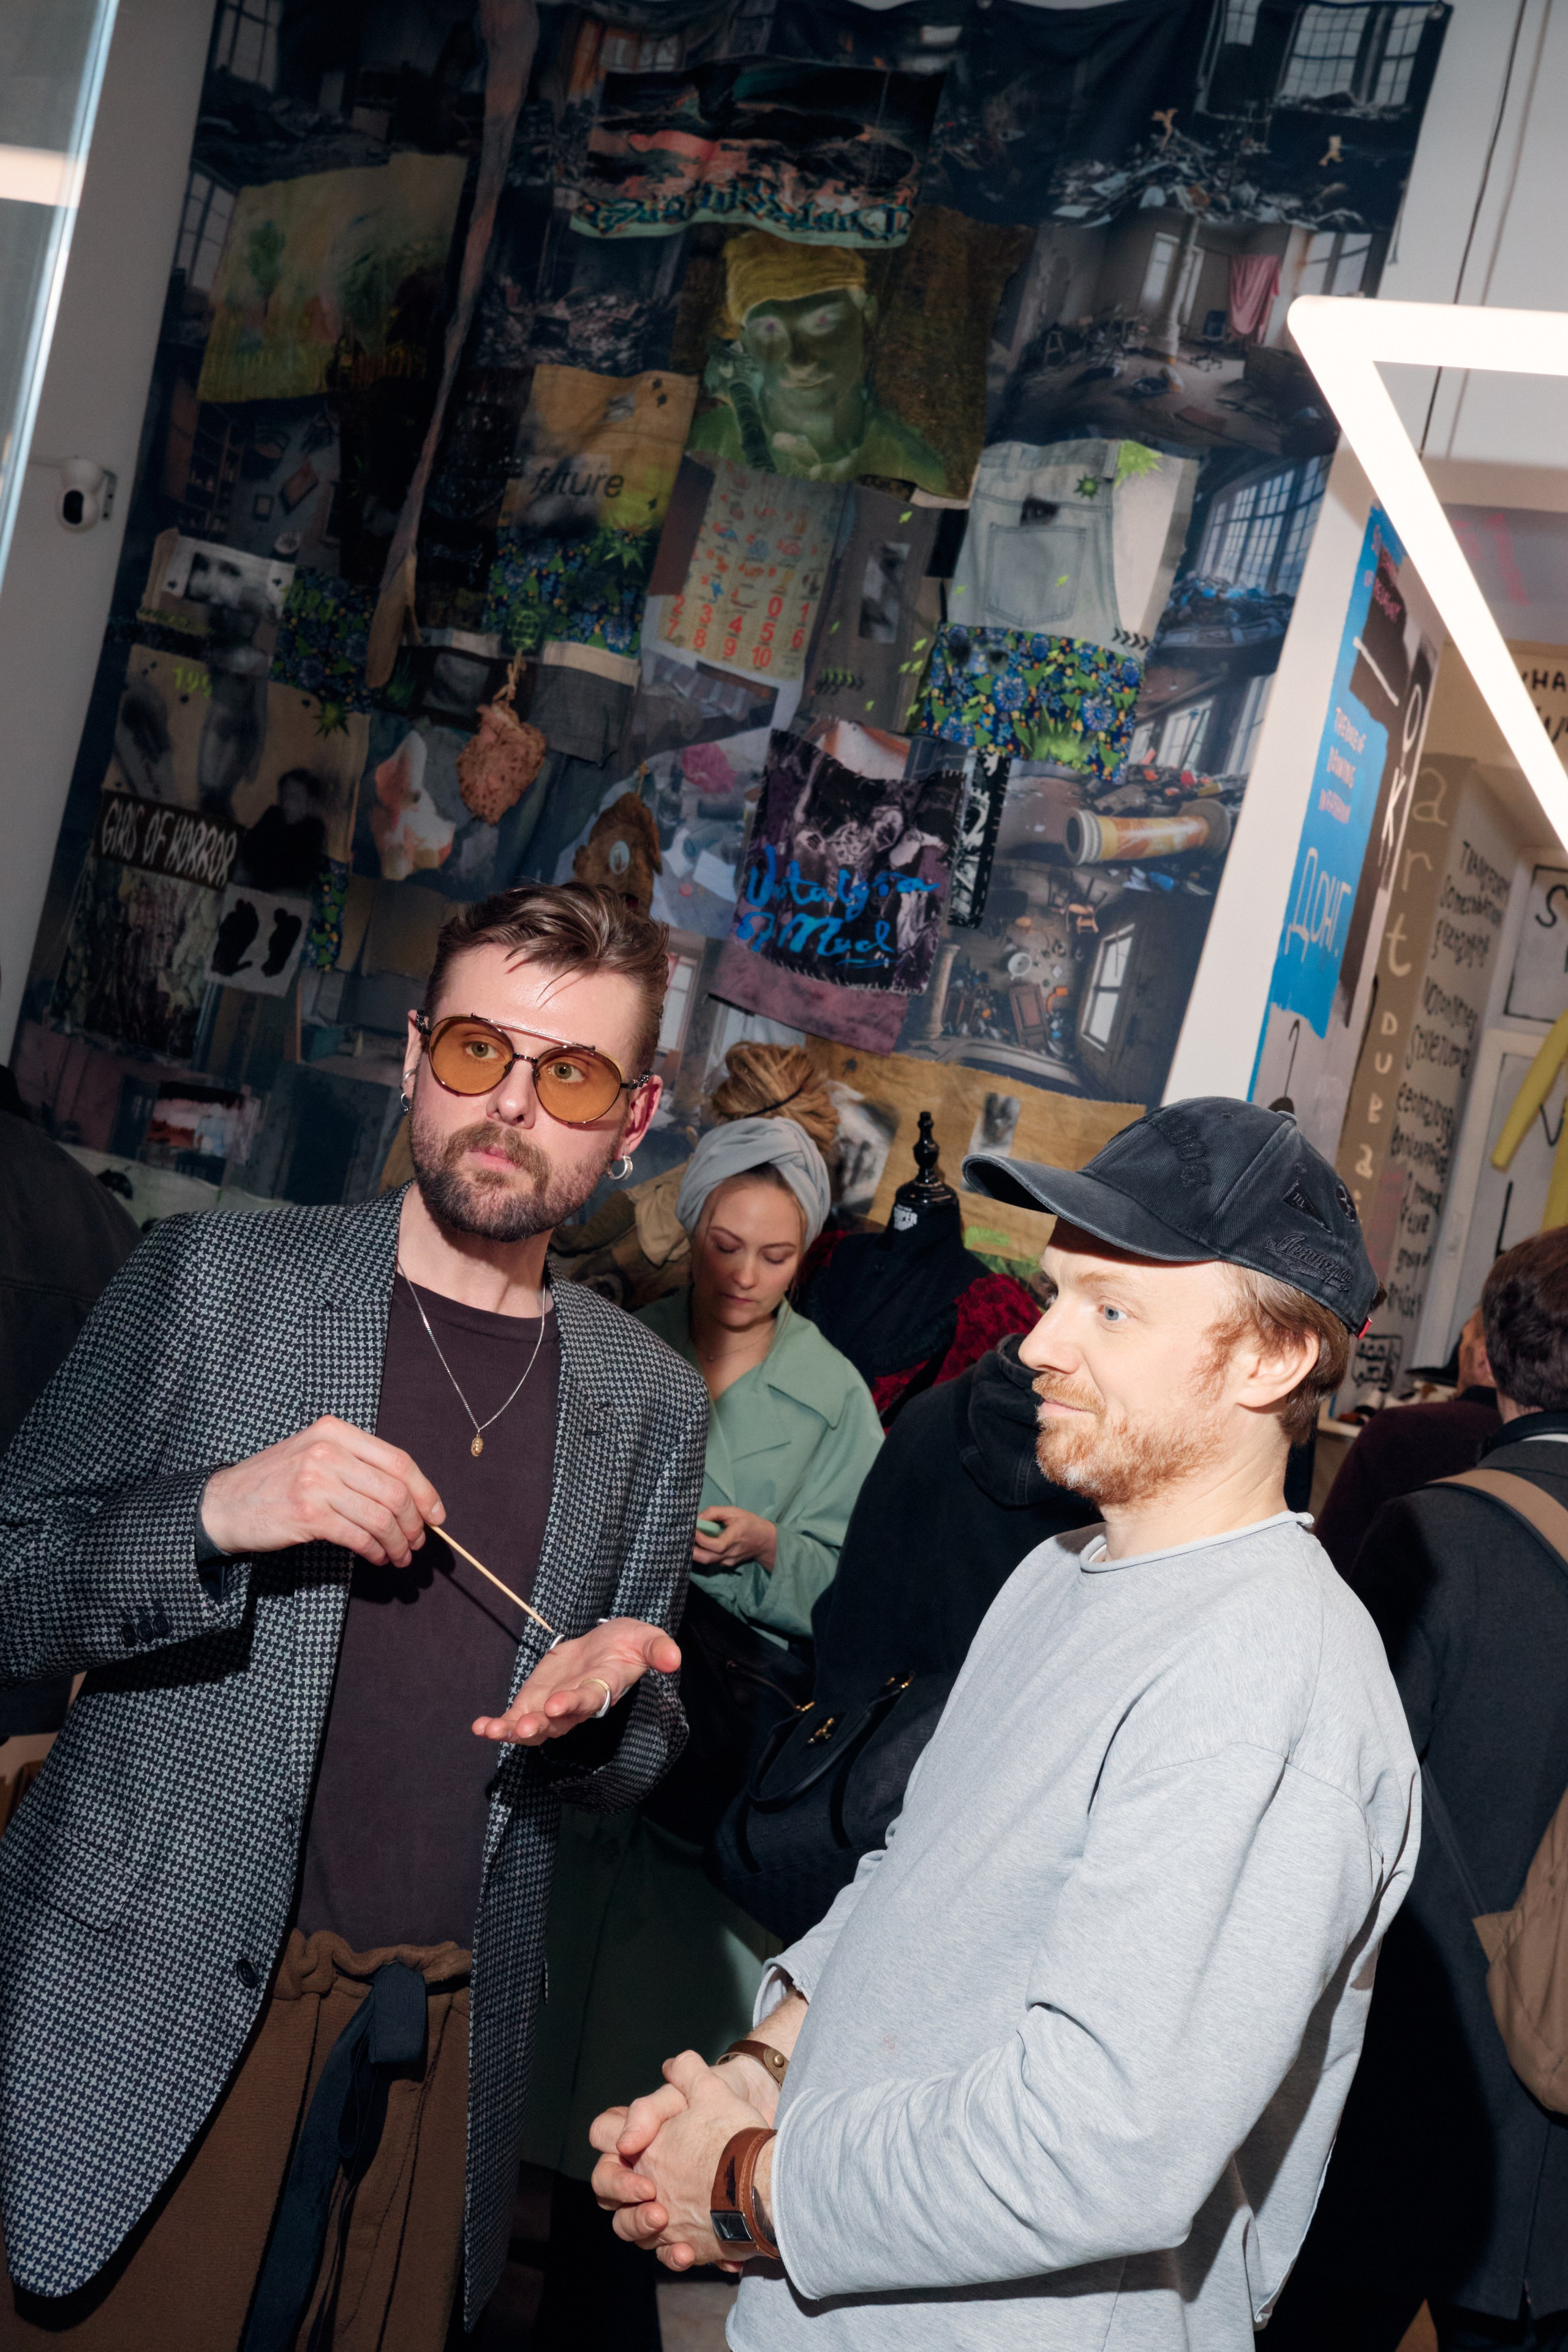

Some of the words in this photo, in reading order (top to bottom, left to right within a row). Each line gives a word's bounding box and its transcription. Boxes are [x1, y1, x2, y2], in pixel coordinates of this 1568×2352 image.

[673, 595, 684, 615] 2
[700, 605, 712, 624] 3
[728, 616, 742, 634] 4
[761, 622, 775, 642] 5
[792, 626, 804, 648] 6
[768, 597, 783, 617] 0
[801, 602, 809, 623] 1
[668, 617, 679, 636] 7
[693, 628, 707, 648] 8
[723, 637, 736, 657] 9
[752, 645, 772, 667] 10
